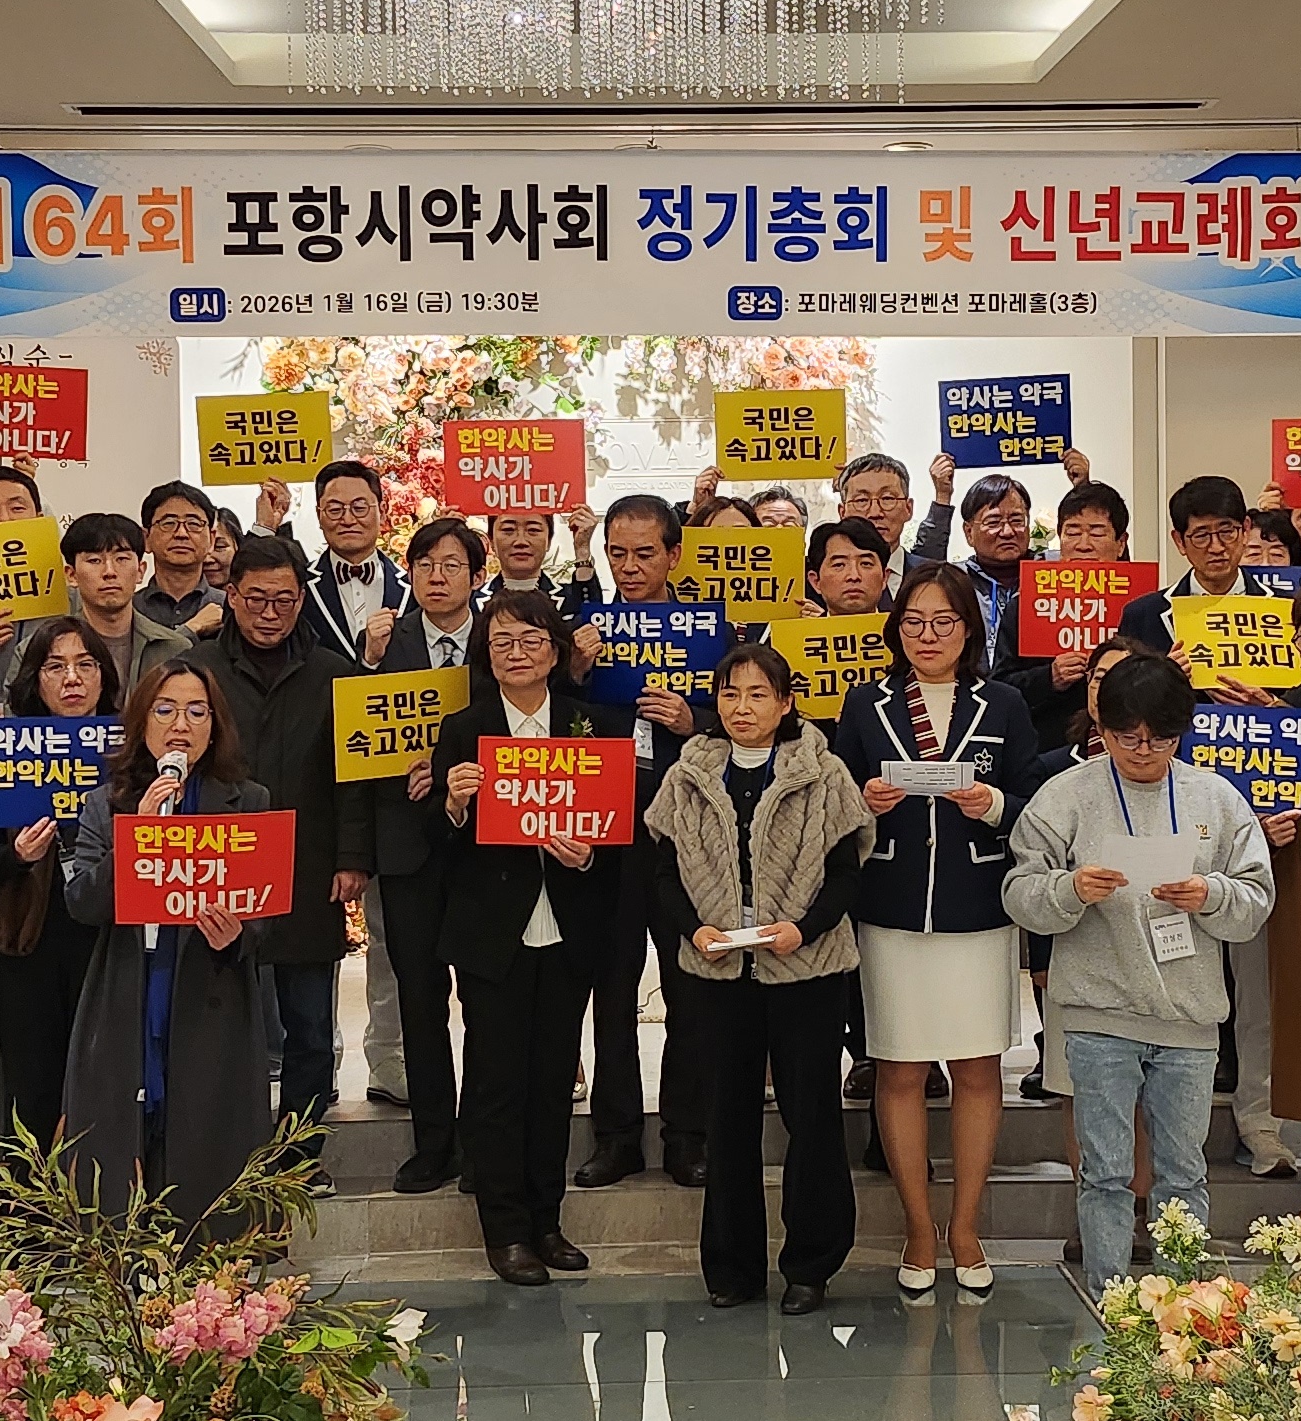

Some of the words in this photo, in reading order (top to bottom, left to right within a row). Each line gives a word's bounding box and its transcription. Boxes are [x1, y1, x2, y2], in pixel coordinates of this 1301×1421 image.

[32, 186, 195, 264] 64회
[224, 184, 608, 262] 포항시약사회
[637, 185, 888, 262] 정기총회
[920, 186, 973, 262] 및
[179, 293, 219, 315] 일시
[241, 294, 313, 314] 2026년
[324, 293, 354, 314] 1월
[364, 292, 409, 313] 16일
[417, 291, 452, 314] (금)
[461, 292, 540, 313] 19:30분
[736, 292, 777, 313] 장소
[797, 293, 959, 314] 포마레웨딩컨벤션
[967, 292, 1097, 315] 포마레홀(3층)
[947, 385, 1013, 410] 약사는
[1019, 382, 1063, 406] 약국
[225, 410, 298, 435] 국민은
[743, 407, 814, 431] 국민은
[948, 411, 1036, 437] 한약사는
[209, 440, 322, 466] 속고있다!
[458, 427, 554, 453] 한약사는
[725, 436, 837, 462] 속고있다!
[999, 436, 1066, 461] 한약국
[459, 456, 532, 481] 약사가
[484, 483, 569, 509] 아니다!
[697, 546, 772, 571] 국민은
[676, 576, 794, 604] 속고있다!
[1035, 569, 1129, 594] 한약사는
[1035, 598, 1107, 622] 약사가
[590, 612, 662, 638] 약사는
[670, 612, 717, 637] 약국
[1206, 613, 1283, 638] 국민은
[804, 634, 884, 663] 국민은
[366, 689, 440, 721] 국민은
[1193, 714, 1272, 743] 약사는
[496, 747, 602, 774] 한약사는
[1193, 746, 1297, 775] 한약사는
[495, 779, 576, 806] 약사가
[521, 811, 615, 840] 아니다!
[134, 825, 257, 853] 한약사는
[135, 859, 227, 886] 약사가
[166, 885, 272, 918] 아니다!
